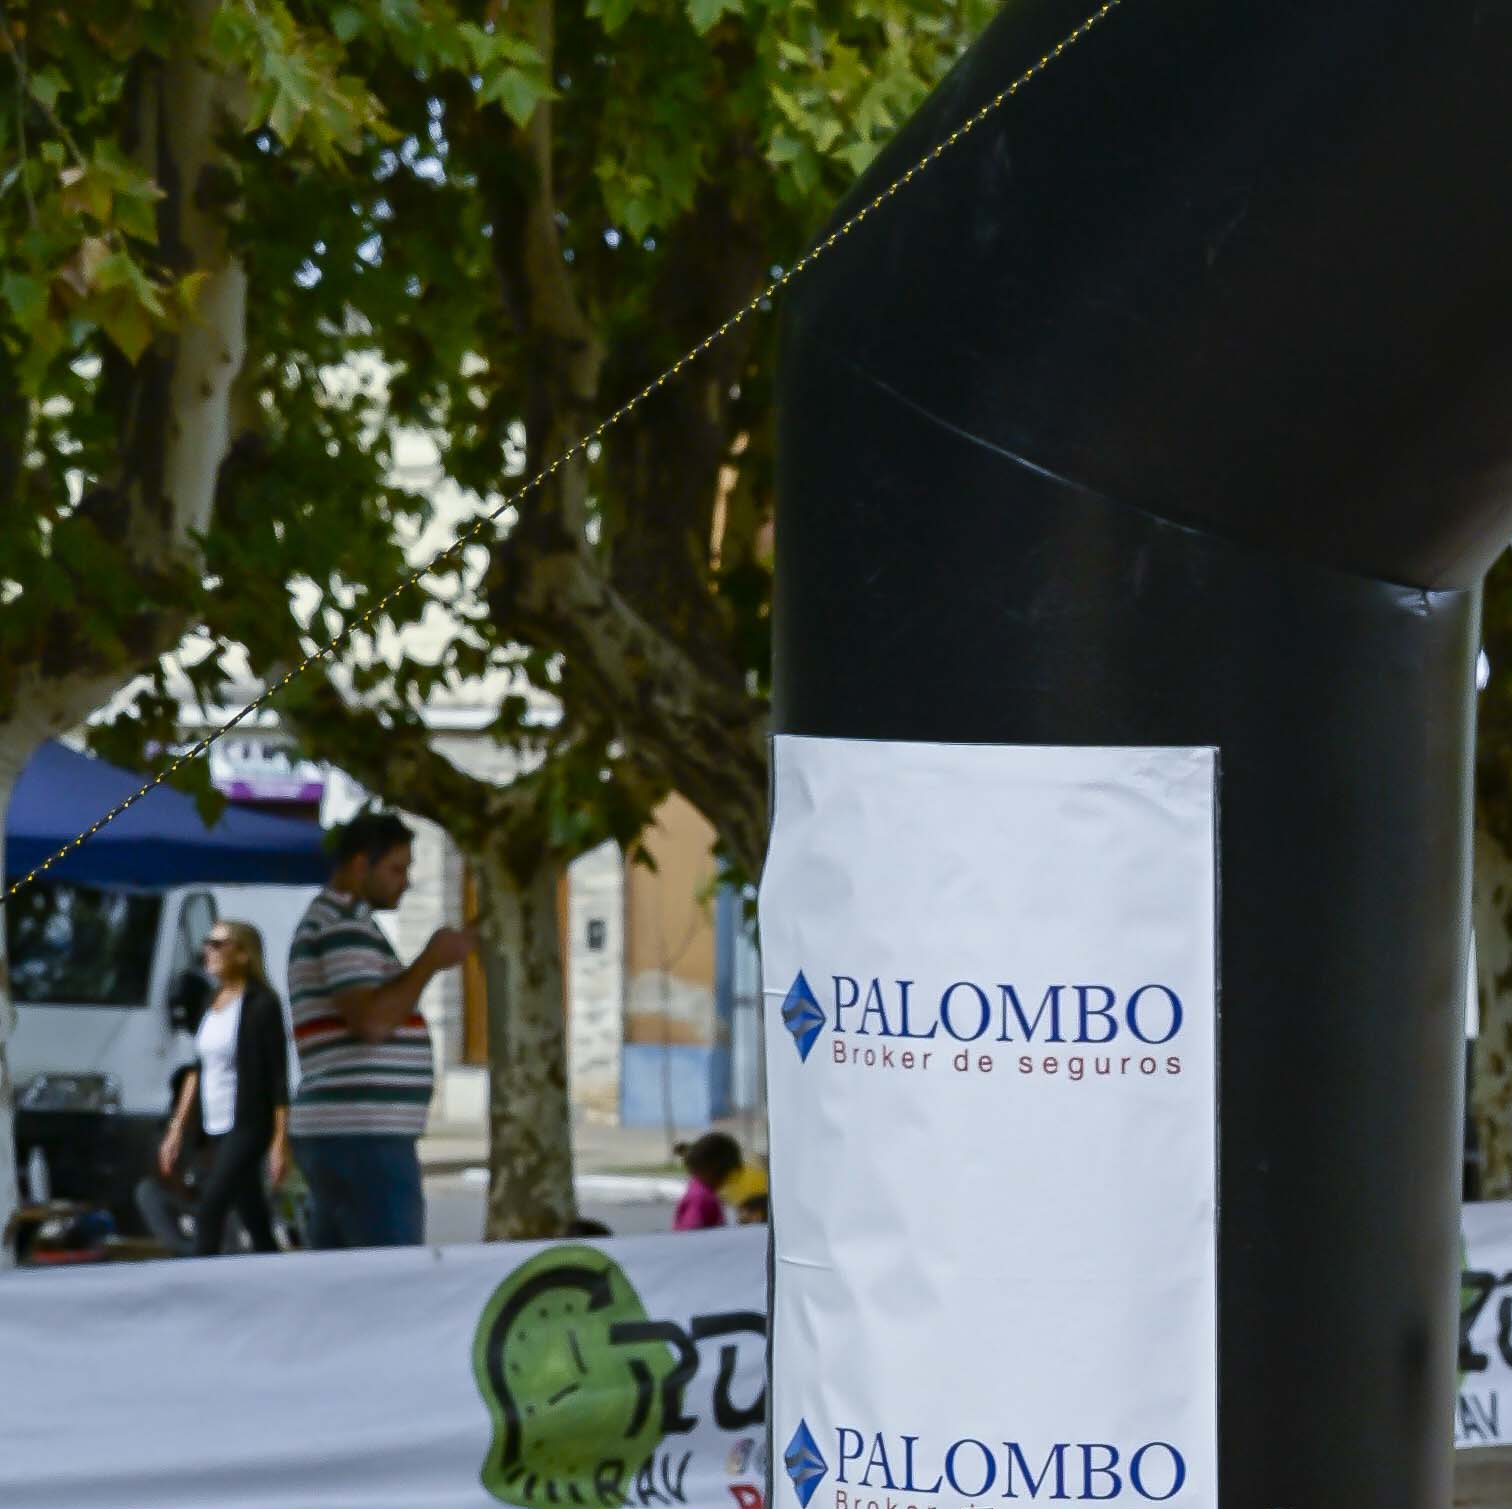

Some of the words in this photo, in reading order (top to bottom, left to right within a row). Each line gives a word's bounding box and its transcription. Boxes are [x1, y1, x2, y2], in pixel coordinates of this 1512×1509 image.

[832, 976, 1183, 1045] PALOMBO
[833, 1040, 932, 1071] Broker
[954, 1048, 993, 1073] de
[1019, 1055, 1182, 1081] seguros
[835, 1427, 1186, 1501] PALOMBO
